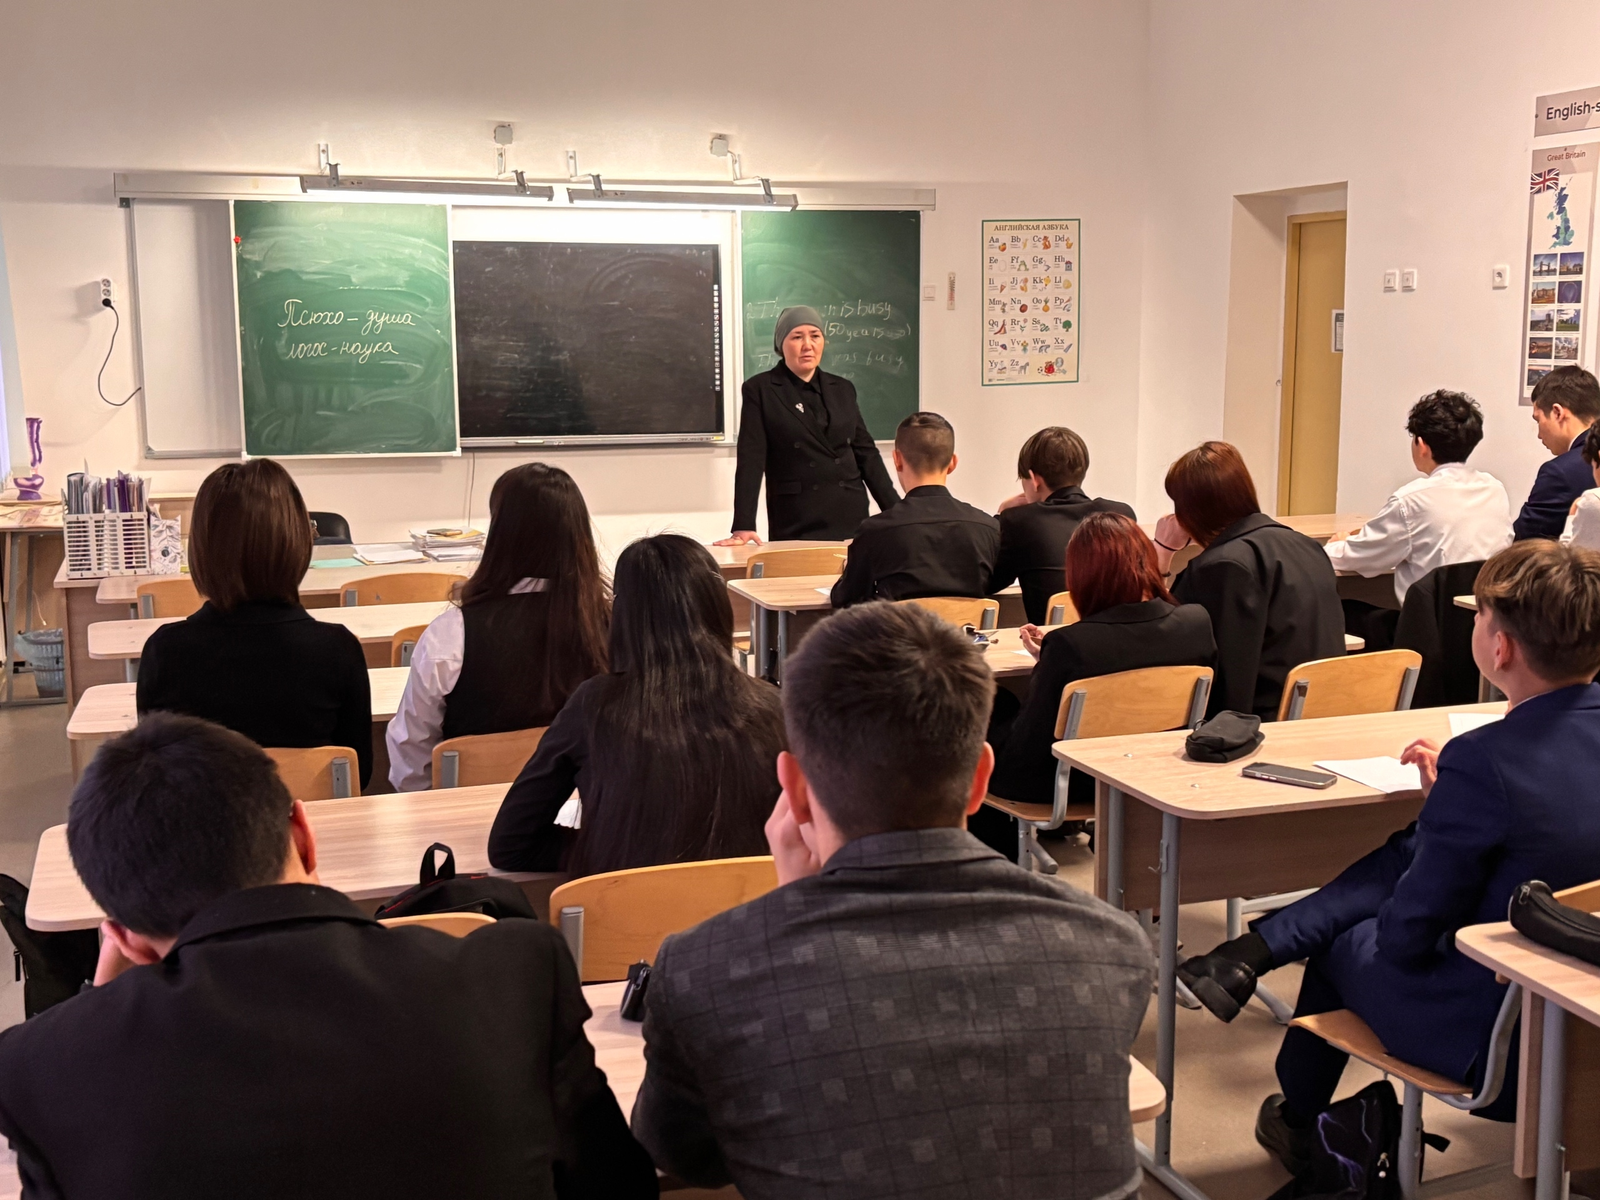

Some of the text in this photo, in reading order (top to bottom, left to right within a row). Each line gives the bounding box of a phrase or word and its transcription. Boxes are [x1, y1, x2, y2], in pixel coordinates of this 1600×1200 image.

[1547, 150, 1586, 162] Great Britain
[994, 224, 1040, 232] АНГЛИЙСКАЯ
[1033, 256, 1043, 264] Gg
[1054, 297, 1064, 305] Pp
[757, 296, 780, 319] Th
[840, 300, 854, 318] is
[857, 299, 891, 321] busy
[361, 309, 416, 336] душа
[989, 319, 998, 327] Qq
